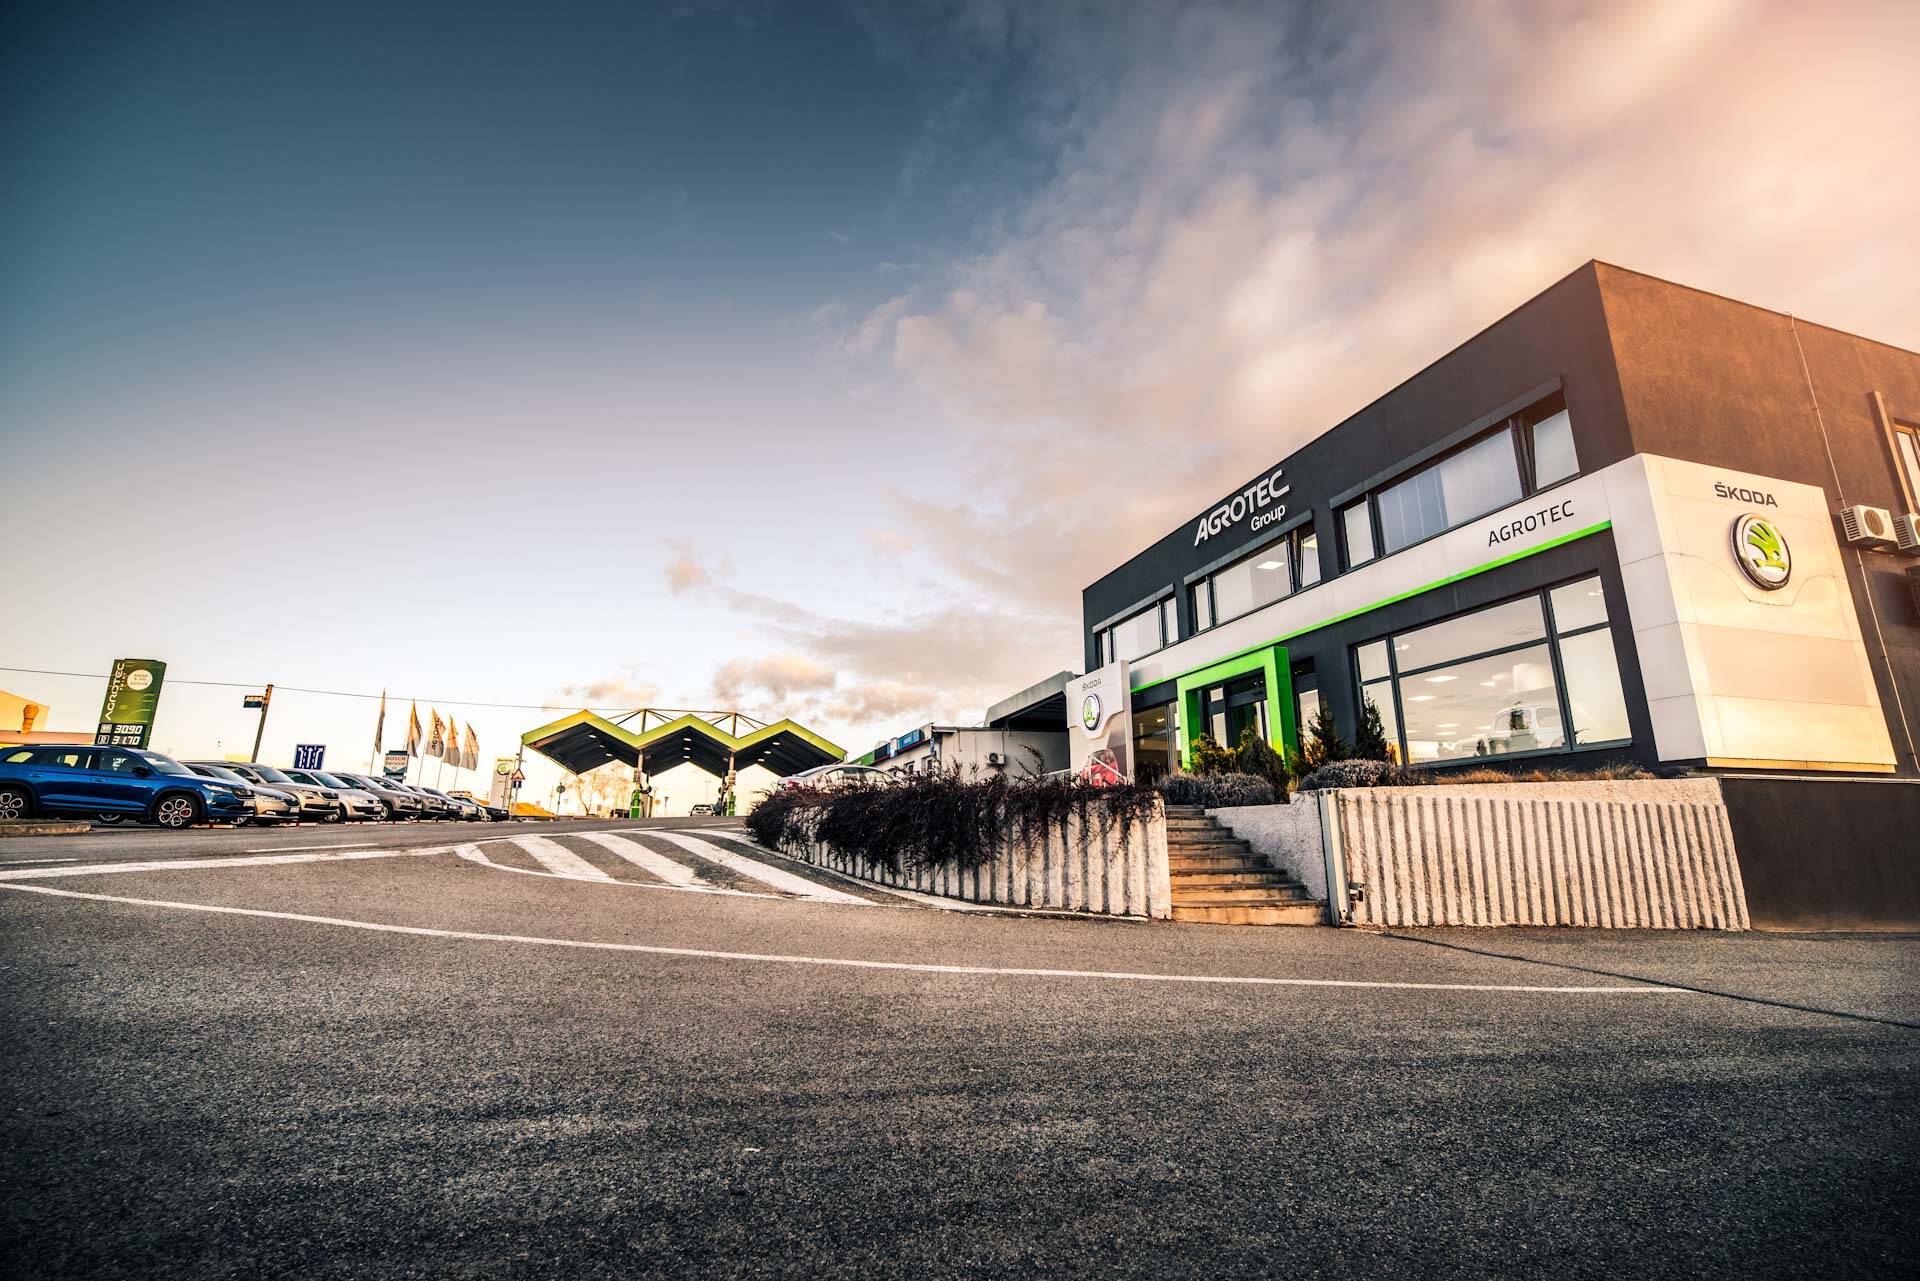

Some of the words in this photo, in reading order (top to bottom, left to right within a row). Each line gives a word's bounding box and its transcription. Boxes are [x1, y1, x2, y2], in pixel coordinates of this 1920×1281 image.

[1194, 469, 1290, 547] AGROTEC
[1250, 504, 1286, 532] Group
[1714, 481, 1779, 508] ŠKODA
[1488, 500, 1575, 547] AGROTEC
[105, 662, 125, 721] AGROTEC
